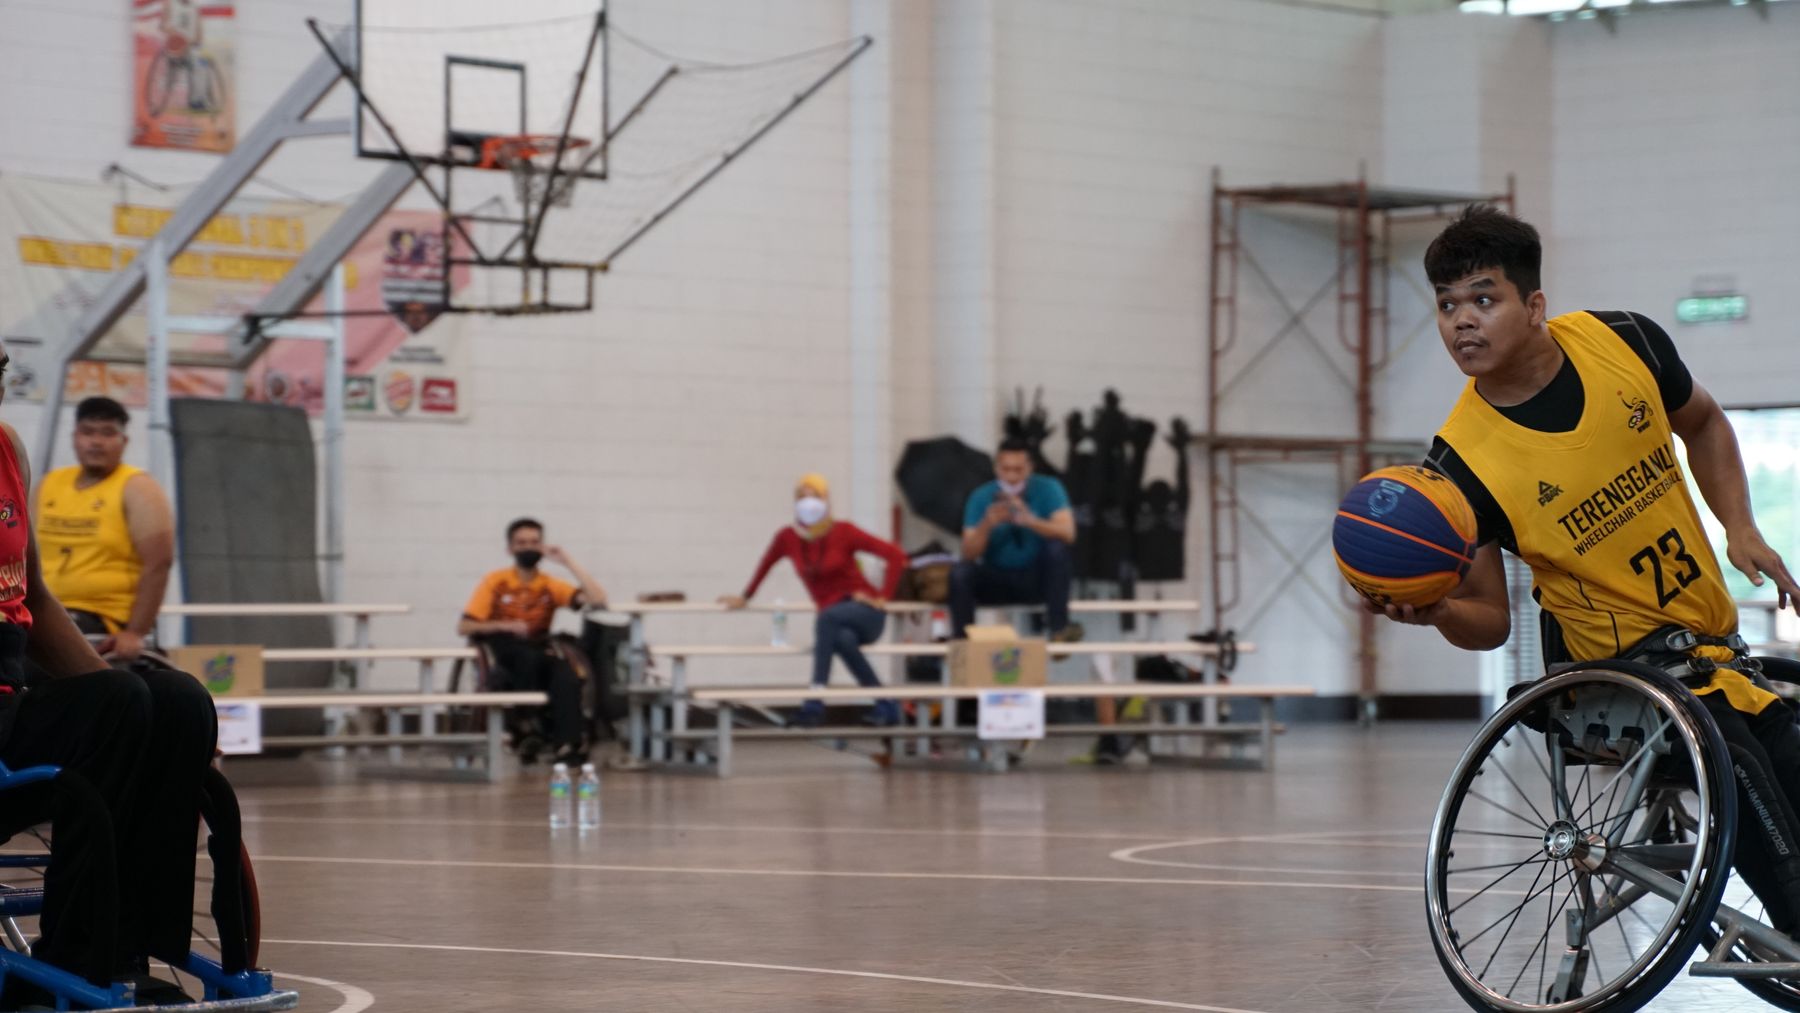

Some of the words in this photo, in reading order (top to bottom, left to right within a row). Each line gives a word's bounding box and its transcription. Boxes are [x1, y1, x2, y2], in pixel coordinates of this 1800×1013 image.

[1557, 443, 1675, 541] TERENGGANU
[1574, 506, 1637, 556] WHEELCHAIR
[1635, 471, 1682, 512] BASKETBALL
[58, 545, 74, 577] 7
[1629, 527, 1701, 609] 23
